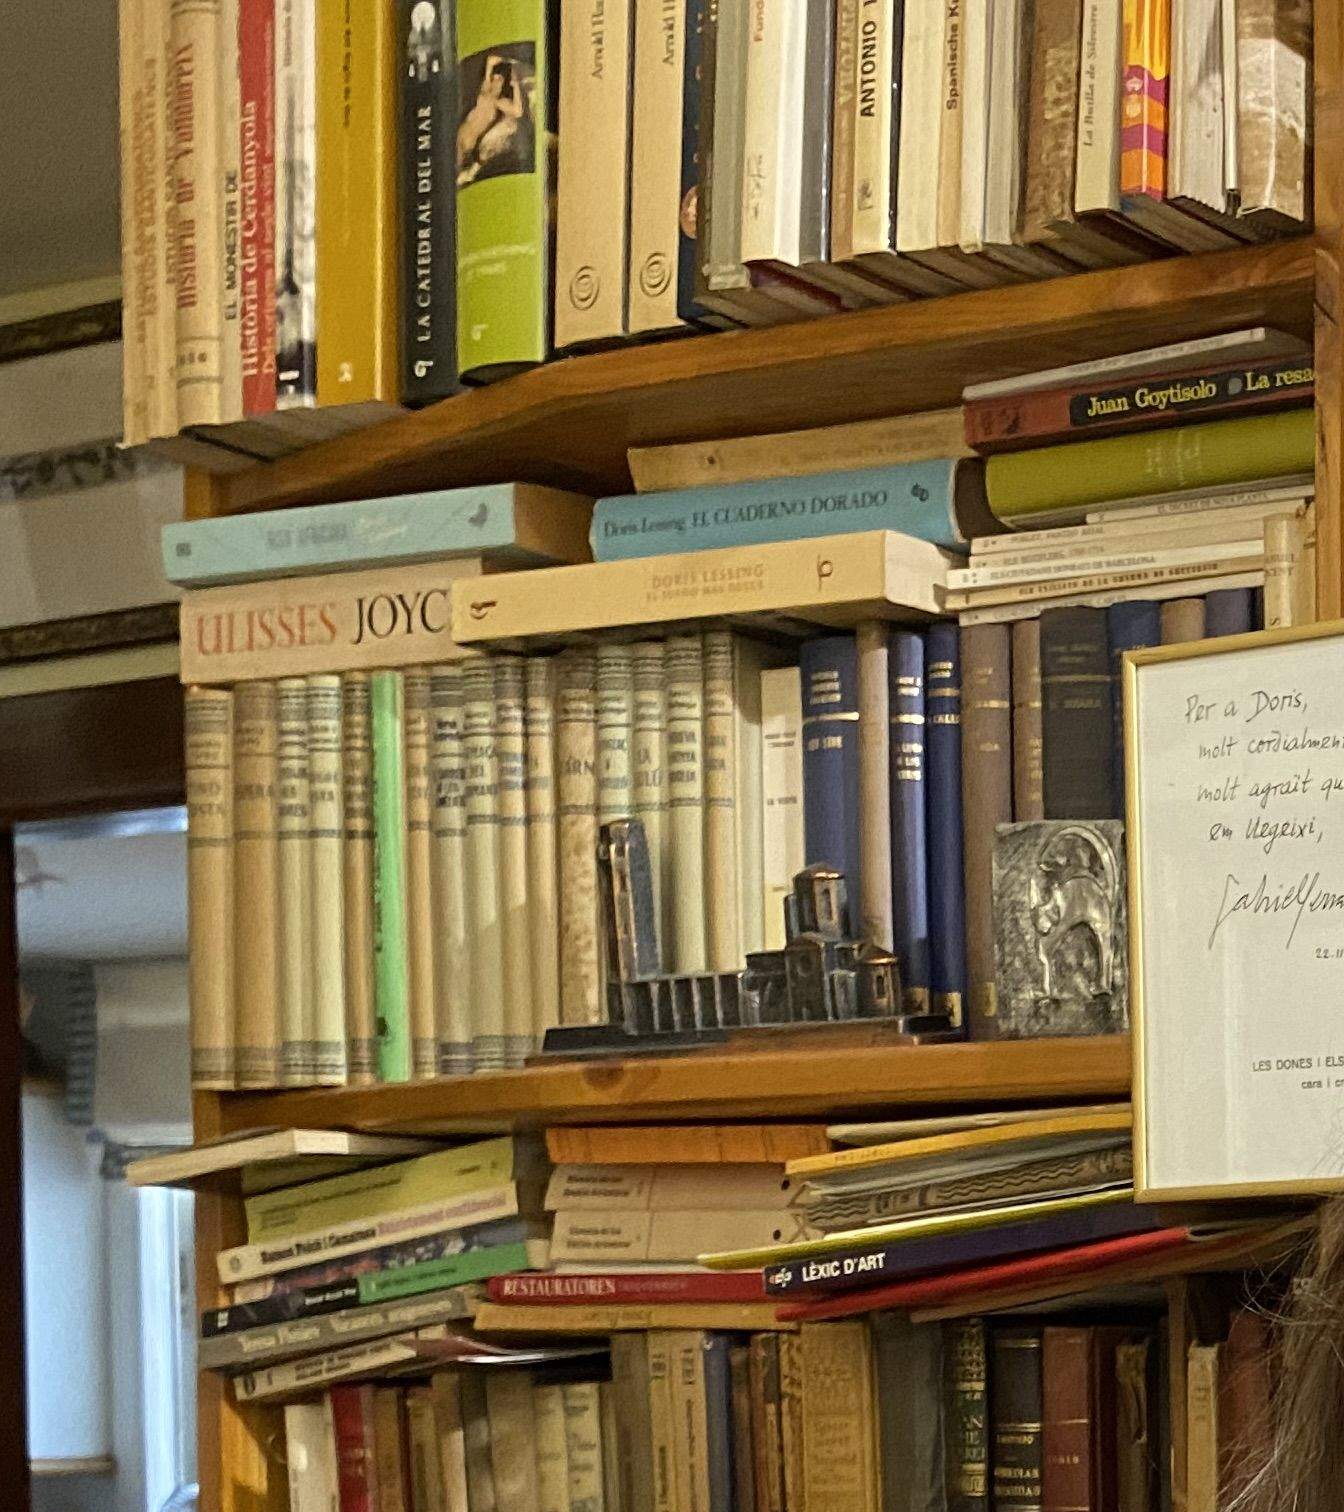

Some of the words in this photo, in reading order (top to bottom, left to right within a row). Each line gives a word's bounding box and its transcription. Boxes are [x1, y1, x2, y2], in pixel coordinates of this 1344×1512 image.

[861, 21, 877, 117] ANTONIO
[418, 106, 431, 149] MAR
[418, 154, 431, 189] DEL
[418, 194, 431, 312] CATEDRAL
[241, 293, 257, 377] Història
[418, 319, 431, 342] LA
[1088, 395, 1129, 416] Juan
[1135, 379, 1217, 410] Goytisolo
[1246, 370, 1270, 391] La
[197, 602, 336, 654] ULISSES
[1185, 693, 1216, 724] Per
[1224, 704, 1237, 717] a
[1244, 689, 1308, 723] Doris,
[1199, 742, 1234, 759] molt
[1198, 776, 1241, 802] molt
[1209, 824, 1233, 841] em
[1252, 1058, 1272, 1072] LES
[1276, 1056, 1312, 1071] DONES
[1317, 1056, 1320, 1068] I
[1326, 1055, 1344, 1068] ELS
[1327, 1076, 1330, 1088] i
[802, 1259, 841, 1283] LÈXIC
[843, 1253, 886, 1276] D'ART
